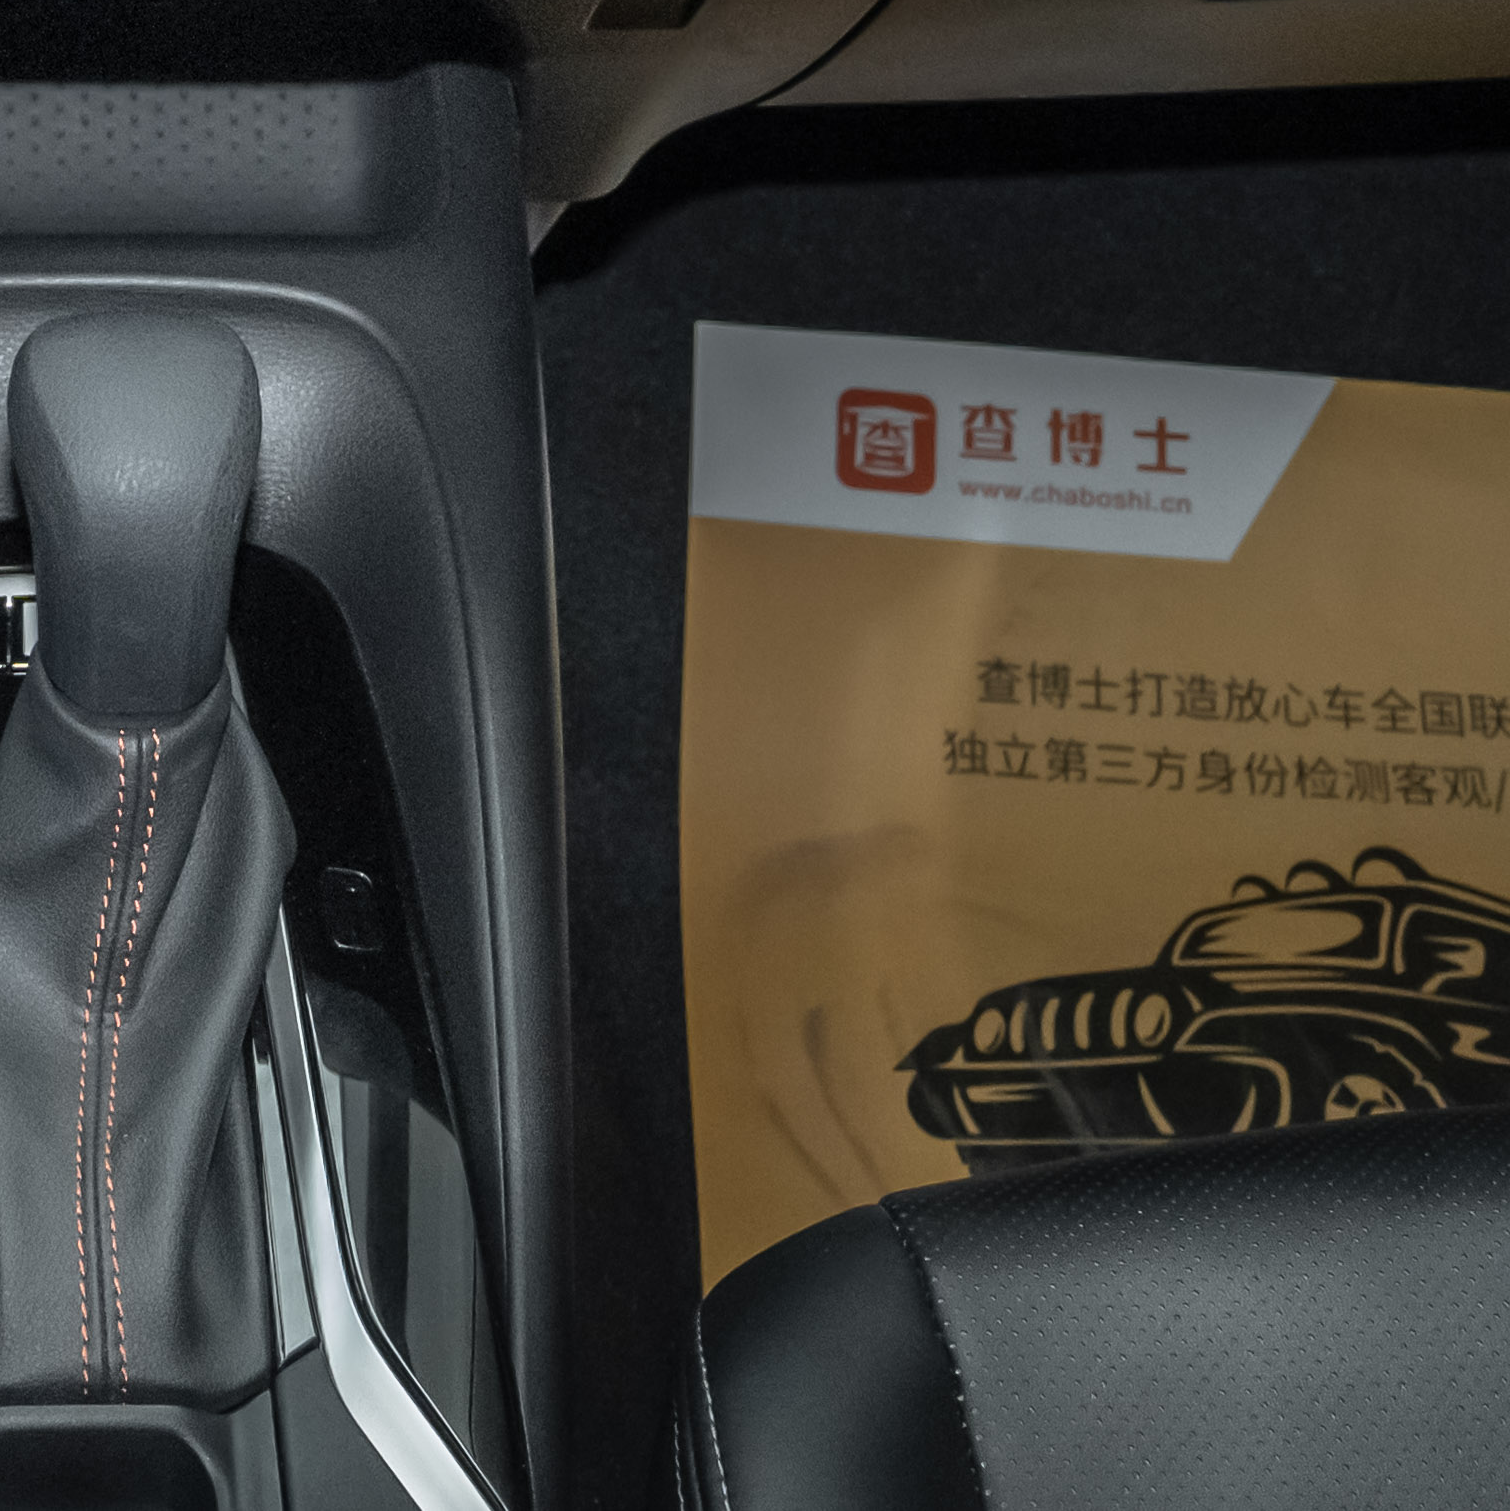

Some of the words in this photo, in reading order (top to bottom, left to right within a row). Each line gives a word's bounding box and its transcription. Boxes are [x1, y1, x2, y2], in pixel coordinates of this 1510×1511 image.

[959, 403, 1191, 476] 查博士
[958, 479, 1193, 516] www.chaboshi.cn
